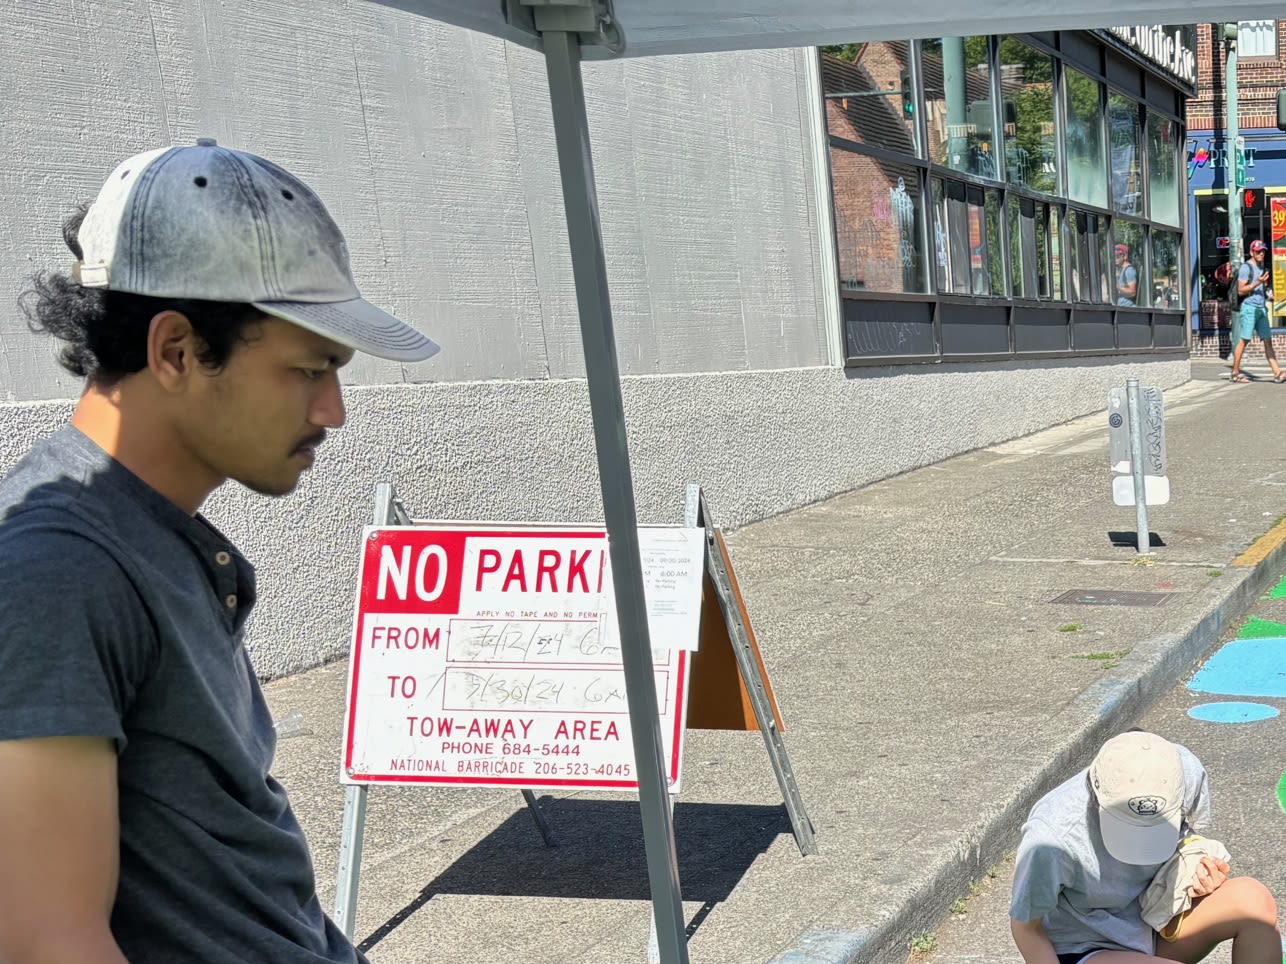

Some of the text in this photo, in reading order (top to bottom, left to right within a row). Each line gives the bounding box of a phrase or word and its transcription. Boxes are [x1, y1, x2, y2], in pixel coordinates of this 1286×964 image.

[1272, 209, 1286, 228] 39
[376, 544, 605, 602] NO PARKI
[476, 611, 599, 620] APPLY NO TAPE AND NO PERM
[371, 626, 441, 650] FROM
[387, 675, 417, 699] TO
[406, 716, 620, 742] TOW-AWAY AREA
[441, 741, 581, 757] PHONE 684-5444
[390, 758, 631, 777] NATIONAL BARRICADE 206-523-4045
